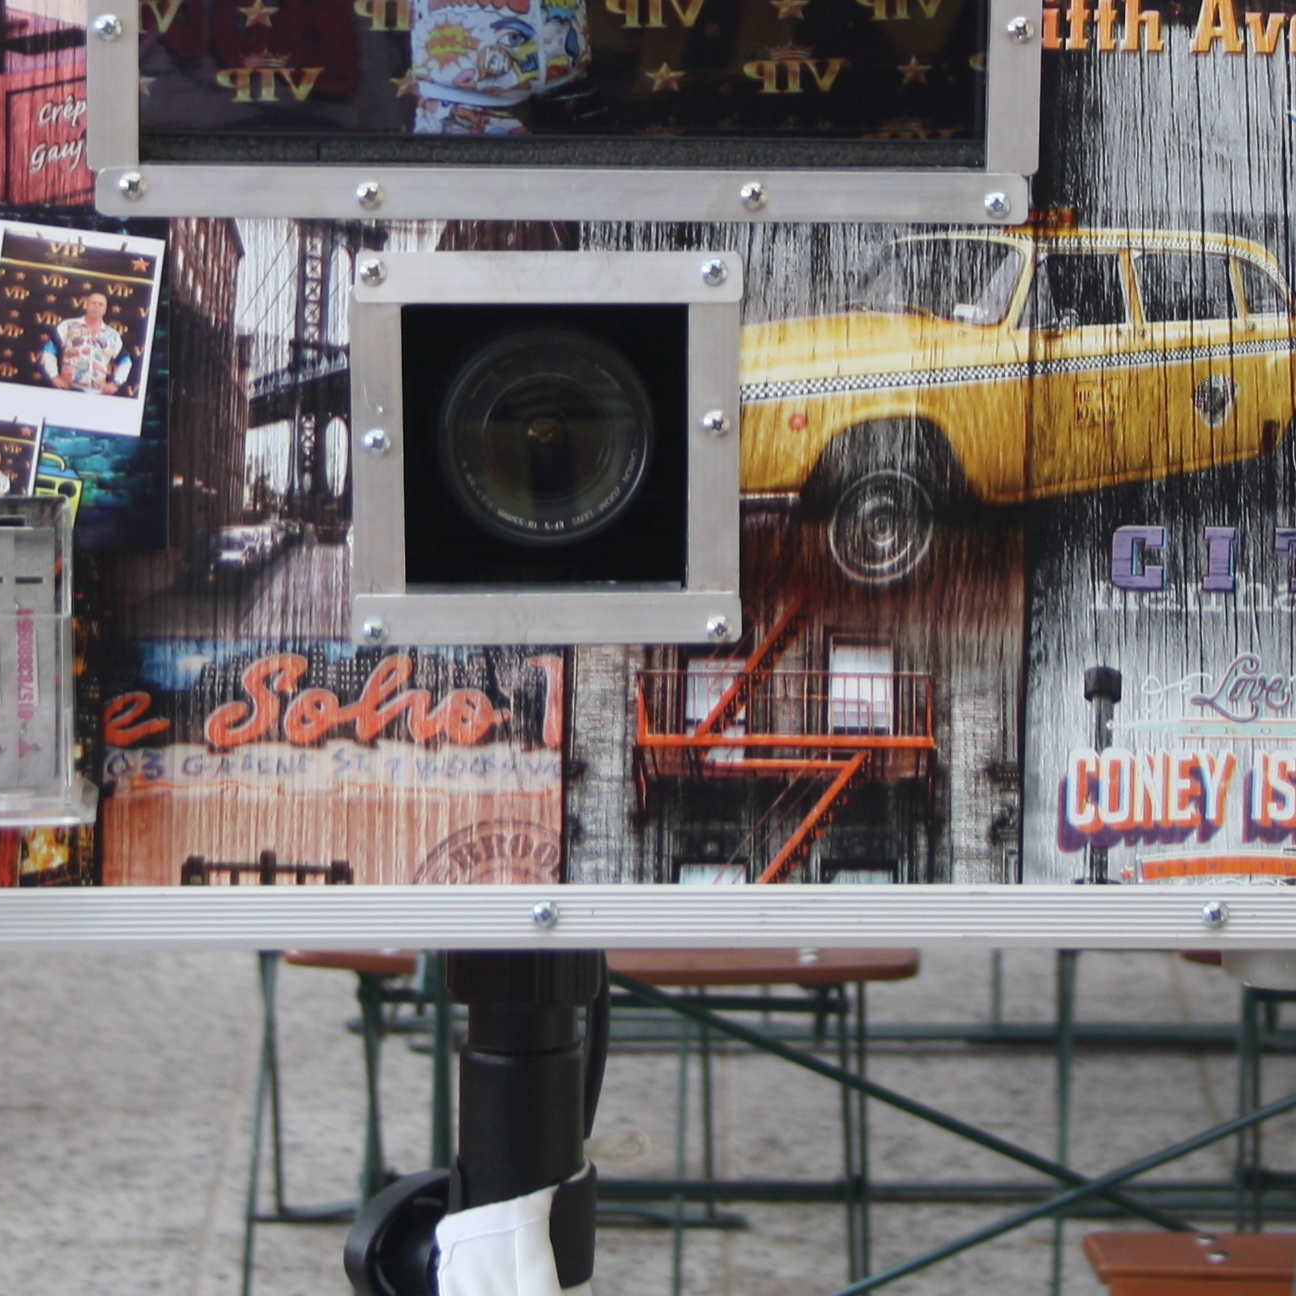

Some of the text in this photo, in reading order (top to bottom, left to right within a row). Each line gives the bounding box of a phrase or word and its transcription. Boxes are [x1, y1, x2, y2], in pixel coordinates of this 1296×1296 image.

[49, 241, 86, 258] VIP
[41, 274, 69, 288] VIP
[4, 287, 30, 301] VIP
[106, 284, 134, 298] VIP
[35, 312, 62, 326] VIP
[1190, 654, 1293, 723] Love
[207, 653, 511, 747] Soho
[1064, 747, 1237, 834] CONEY
[1157, 860, 1218, 874] NEW
